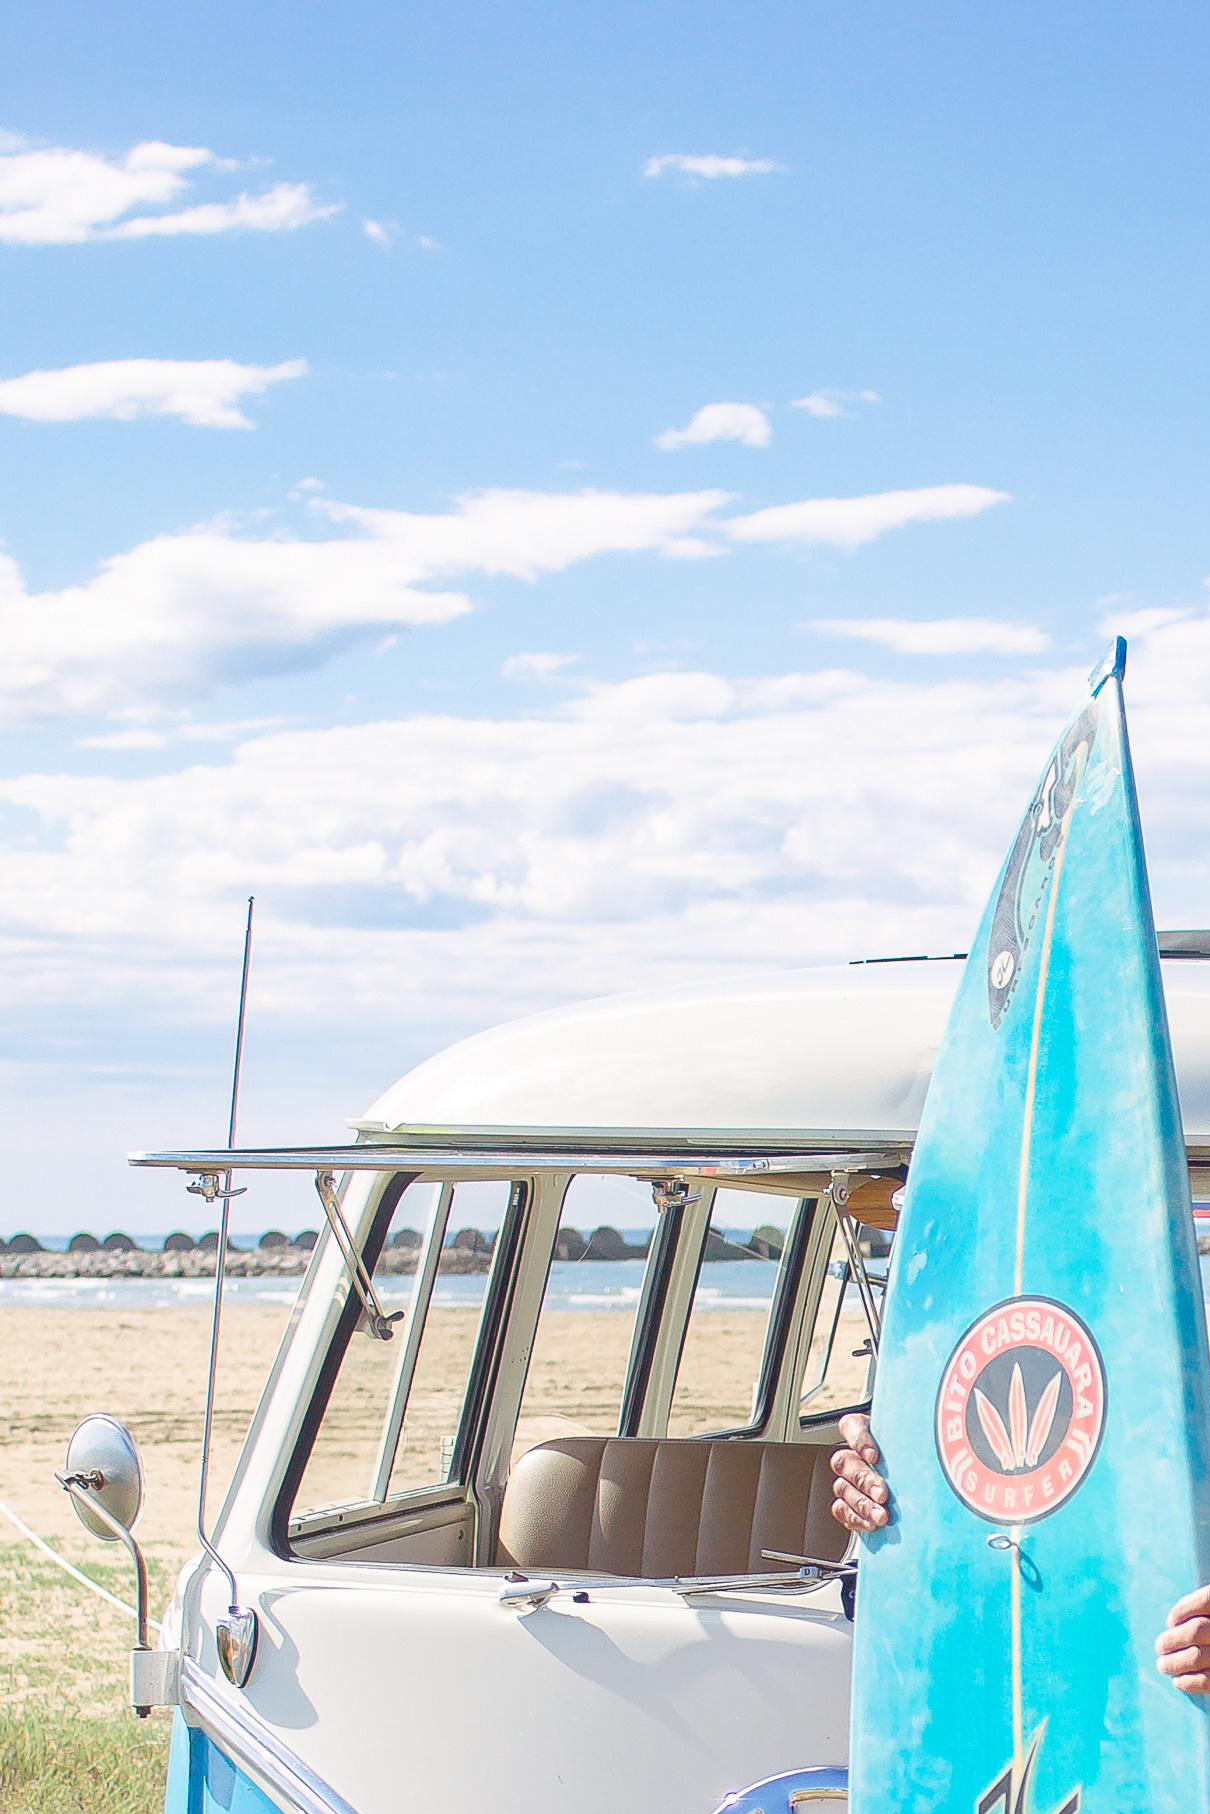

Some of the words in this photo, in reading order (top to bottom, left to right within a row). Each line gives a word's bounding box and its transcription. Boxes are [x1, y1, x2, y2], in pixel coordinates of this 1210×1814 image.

[947, 1350, 977, 1442] BITO
[981, 1311, 1094, 1419] CASSAUARA
[965, 1459, 1074, 1508] SURFER
